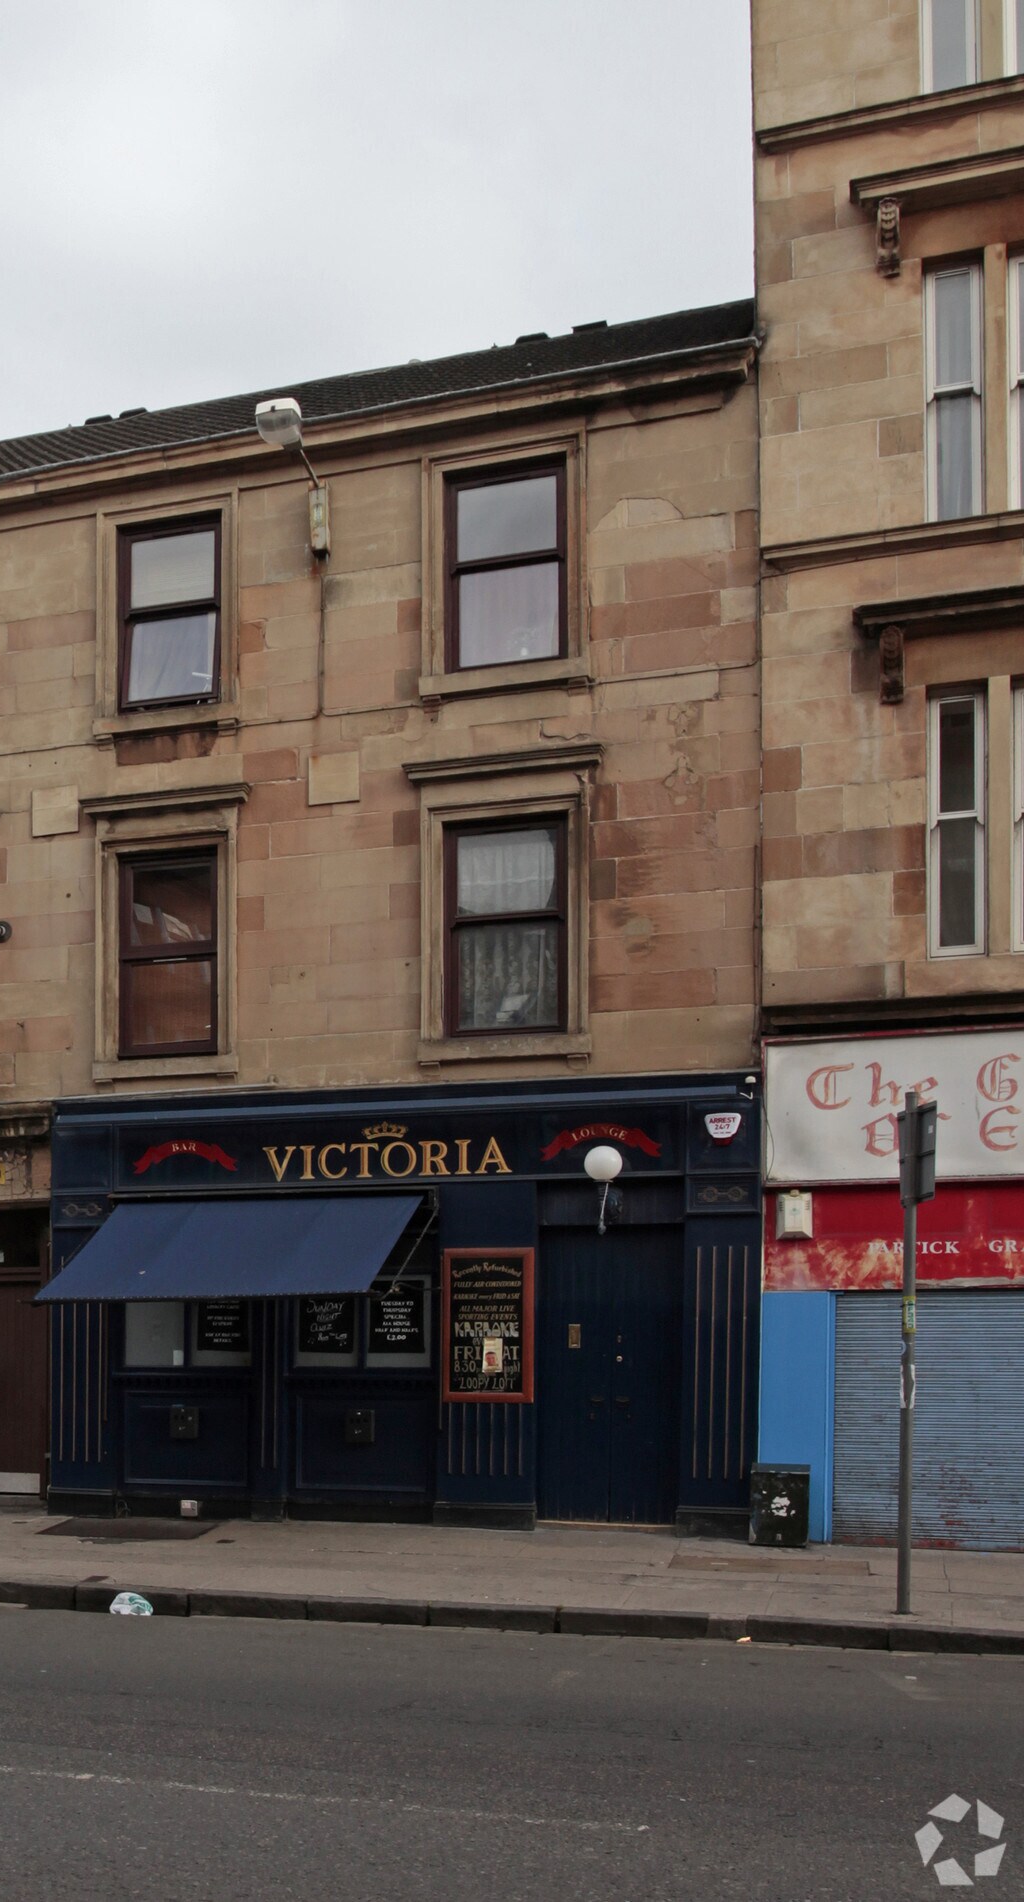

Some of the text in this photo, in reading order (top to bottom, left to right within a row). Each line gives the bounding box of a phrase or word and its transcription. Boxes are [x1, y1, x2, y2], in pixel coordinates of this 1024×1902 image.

[806, 1061, 939, 1111] The
[709, 1116, 736, 1124] ARREST
[571, 1127, 628, 1142] LOUNGE
[171, 1142, 197, 1152] BAR
[262, 1135, 513, 1183] VICTORIA
[988, 1239, 1024, 1254] GR
[471, 1304, 498, 1312] MAJOR
[499, 1304, 516, 1312] LIVE
[490, 1313, 519, 1321] EVENTS
[454, 1321, 520, 1338] KARAOKE
[454, 1345, 482, 1360] FRI
[502, 1345, 520, 1360] AT
